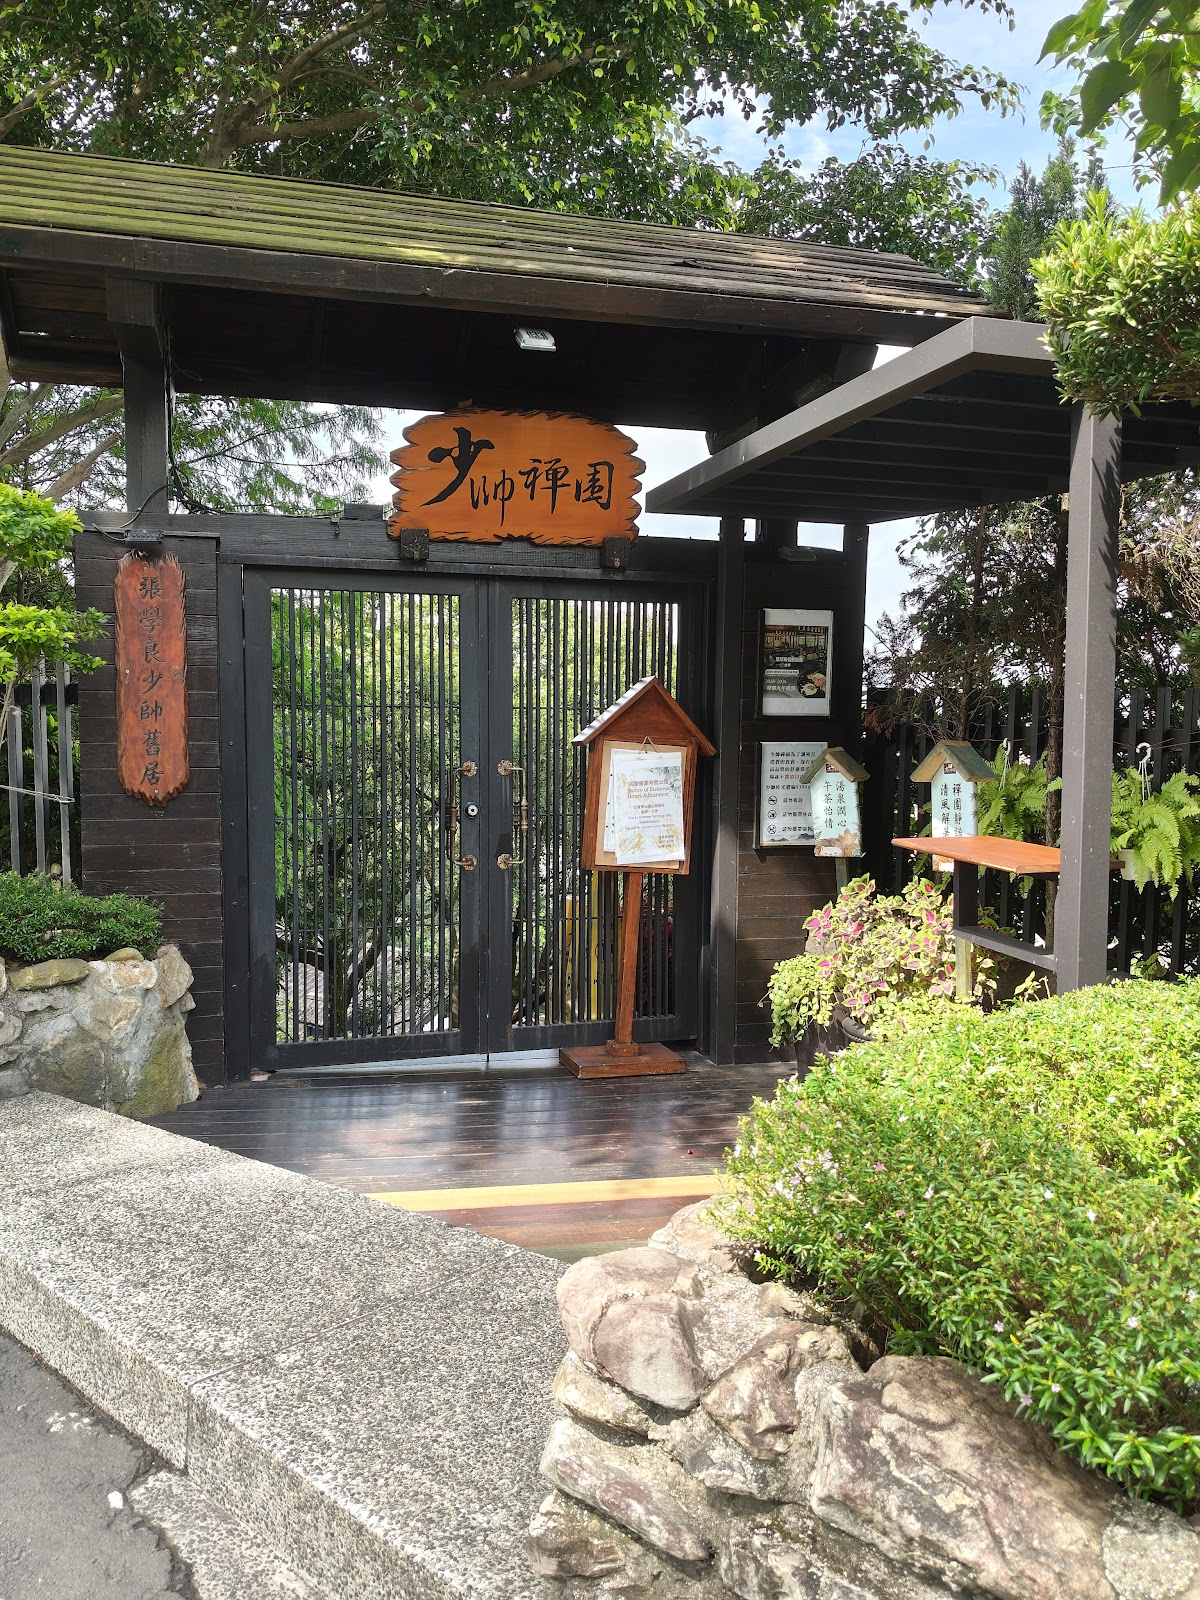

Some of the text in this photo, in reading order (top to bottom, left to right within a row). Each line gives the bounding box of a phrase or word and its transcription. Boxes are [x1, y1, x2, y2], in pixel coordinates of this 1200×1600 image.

[420, 426, 615, 528] 少帥禪園
[138, 576, 165, 787] 張學良少帥舊居
[643, 791, 670, 799] Adjustment
[822, 780, 834, 829] 午茶怡情
